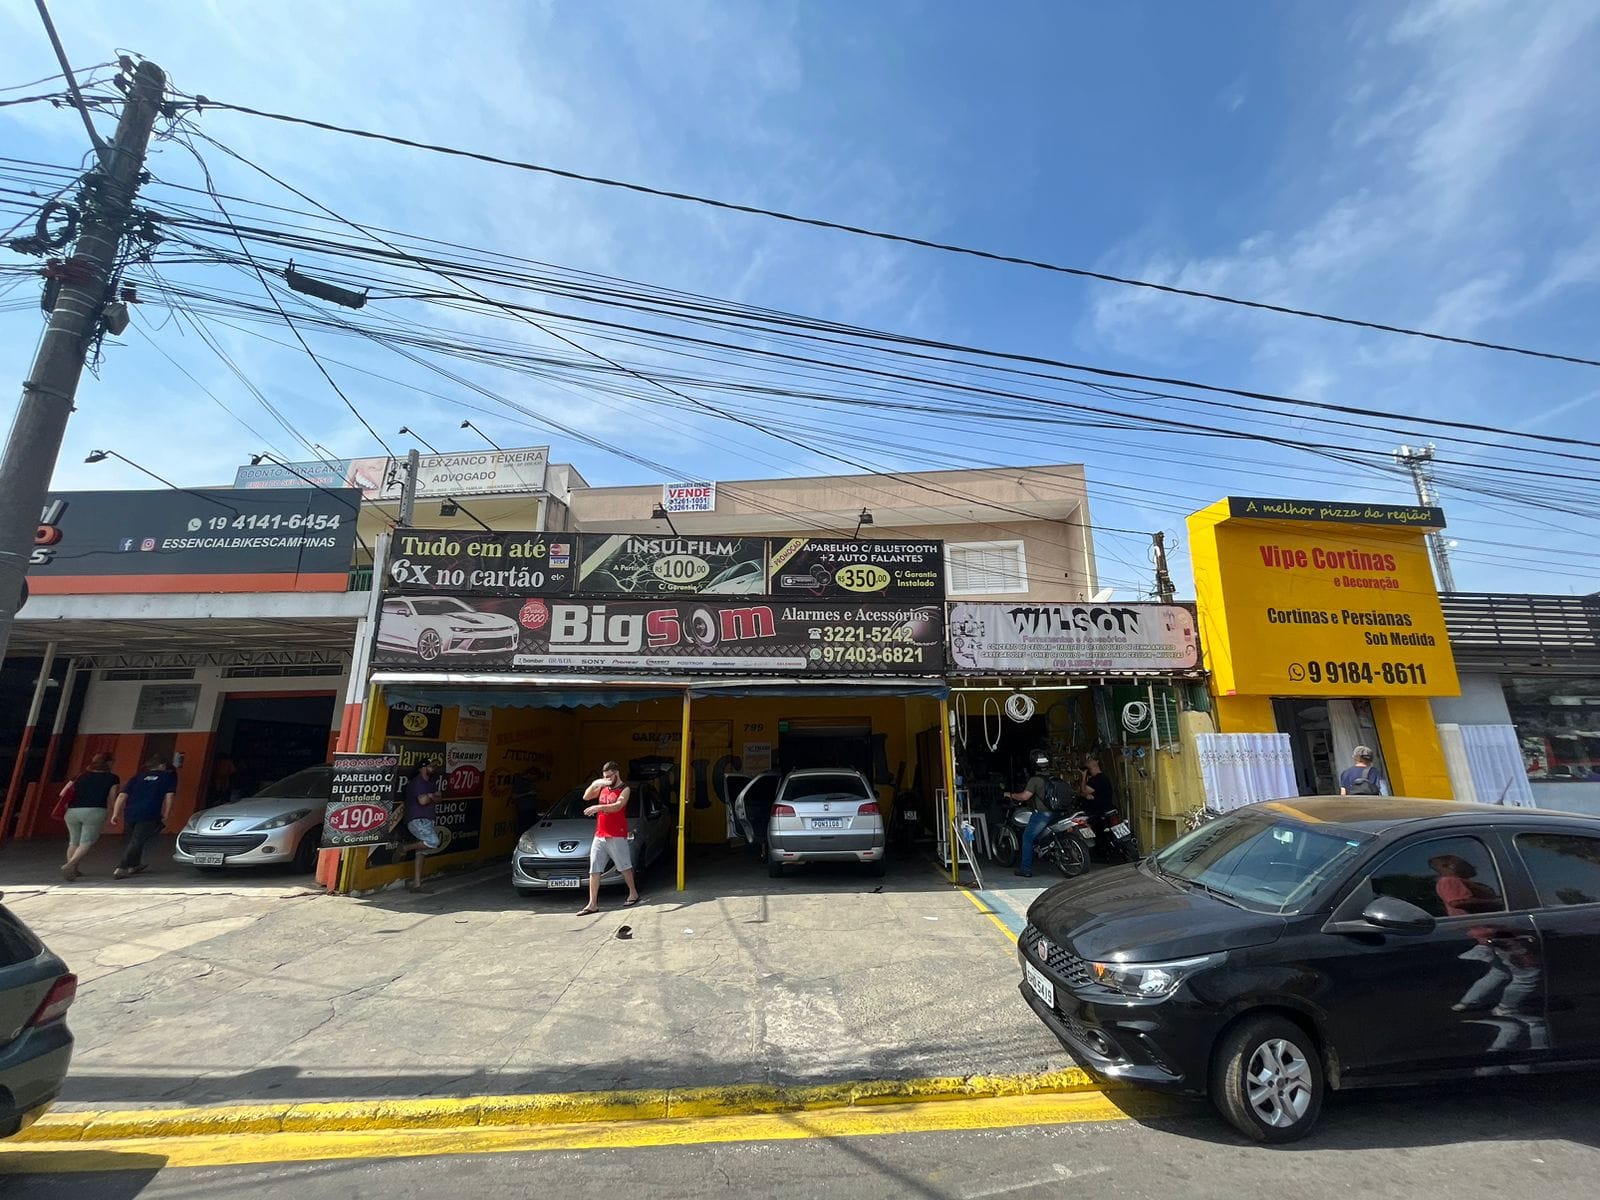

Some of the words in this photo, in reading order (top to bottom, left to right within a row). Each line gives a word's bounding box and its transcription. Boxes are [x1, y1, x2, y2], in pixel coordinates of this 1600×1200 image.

[444, 456, 486, 467] ZANCO
[490, 452, 543, 464] TEIXEIRA
[240, 468, 282, 479] ODONTO
[432, 470, 496, 483] ADVOGADO
[669, 488, 710, 498] VENDE
[1246, 501, 1258, 513] A
[1263, 502, 1315, 516] melhor
[1320, 505, 1361, 520] pizza
[1364, 507, 1383, 519] da
[1387, 509, 1431, 523] região!
[208, 517, 227, 530] 19
[231, 514, 340, 530] 4141-6454
[162, 537, 336, 549] ESSENCIALBIKESCAMPINAS
[401, 536, 461, 557] Tudo
[467, 542, 503, 557] em
[509, 538, 546, 558] até
[626, 539, 734, 555] INSULFILM
[803, 543, 858, 553] APARELHO
[861, 544, 874, 553] C/
[875, 544, 938, 553] BLUETOOTH
[838, 554, 868, 562] AUTO
[871, 555, 923, 563] FALANTES
[1259, 545, 1308, 569] Vipe
[1311, 547, 1396, 572] Cortinas
[436, 570, 465, 586] no
[470, 567, 545, 588] cartão
[551, 573, 565, 581] elo
[894, 570, 903, 578] C/
[905, 570, 938, 578] Garantia
[897, 579, 935, 587] Instalado
[1333, 577, 1341, 587] e
[1342, 575, 1399, 590] Decoração
[522, 614, 545, 623] 2000
[781, 607, 841, 621] Alarmes
[844, 611, 852, 620] e
[855, 608, 929, 622] Acessórios
[1006, 607, 1142, 635] WILSON
[1267, 607, 1329, 624] Cortinas
[1331, 613, 1338, 625] e
[1341, 609, 1412, 626] Persianas
[823, 626, 914, 642] 3221-5242
[1364, 632, 1388, 646] Sob
[1391, 632, 1435, 647] Medida
[823, 647, 923, 663] 97403-6821
[1308, 660, 1322, 683] 9
[1326, 661, 1427, 684] 9184-8611
[335, 756, 398, 768] PROMOÇÃO
[332, 774, 383, 782] APARELHO
[384, 773, 395, 782] C/
[331, 784, 392, 794] BLUETOOTH
[341, 793, 381, 802] Instalado
[343, 834, 379, 843] Garantia
